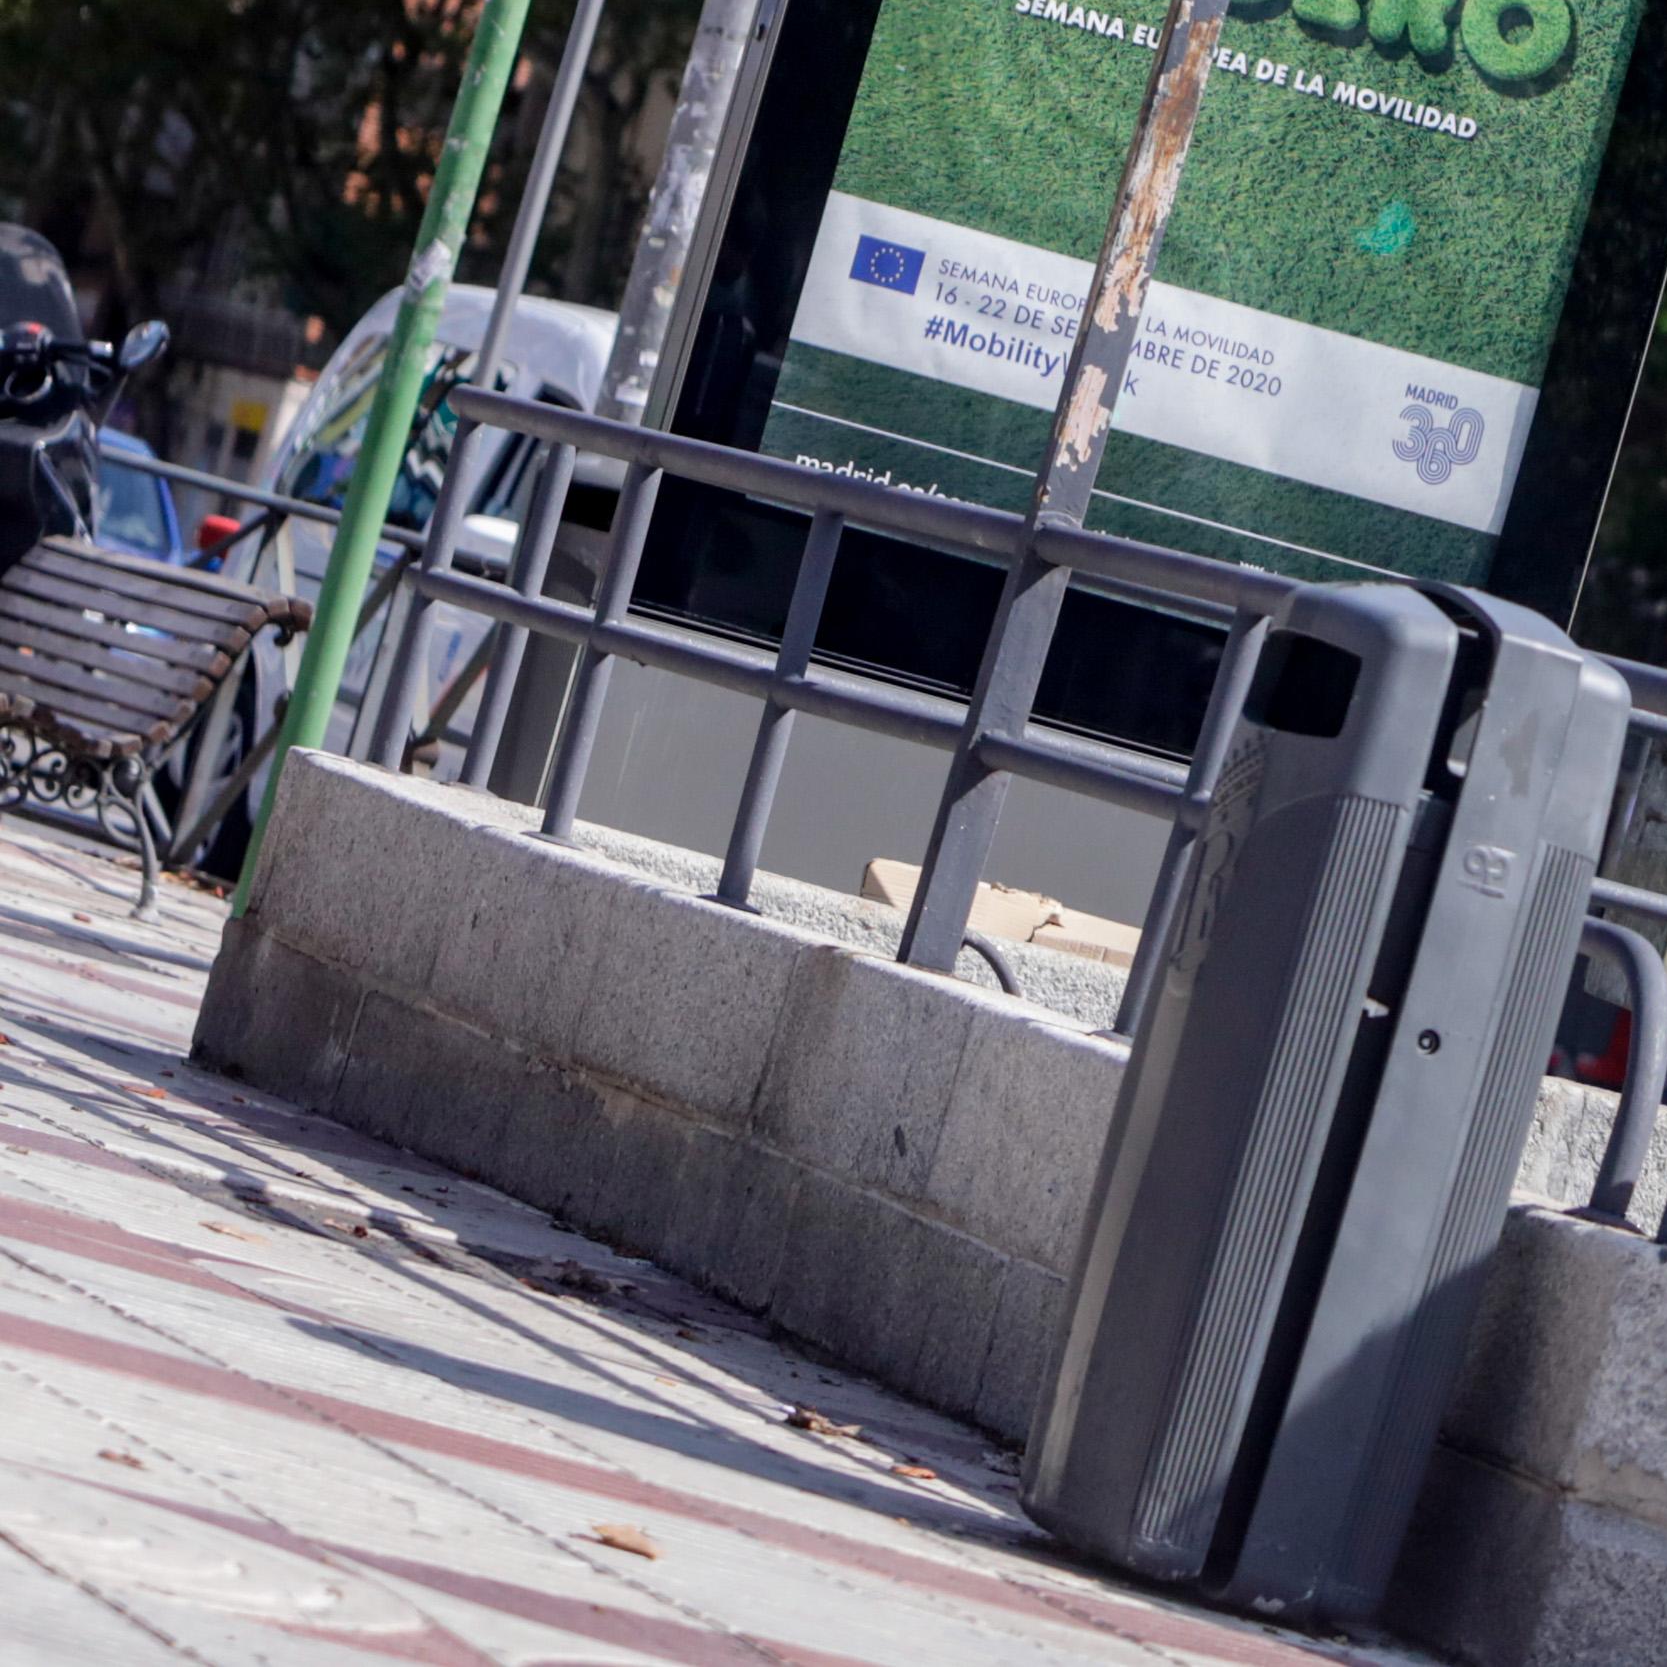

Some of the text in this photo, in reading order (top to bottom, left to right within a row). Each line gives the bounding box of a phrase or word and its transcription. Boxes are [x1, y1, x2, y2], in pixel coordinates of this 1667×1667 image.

[1255, 57, 1289, 86] DE
[1293, 68, 1326, 97] LA
[1331, 81, 1478, 141] MOVILIDAD
[938, 257, 1087, 312] SEMANA EUROP
[933, 282, 957, 306] 16
[976, 294, 1007, 319] 22
[1013, 304, 1042, 330] DE
[1189, 353, 1220, 377] DE
[1225, 364, 1283, 397] 2020
[1145, 316, 1275, 367] LA MOVILIDAD
[1404, 382, 1459, 411] MADRID
[1391, 404, 1485, 485] 360
